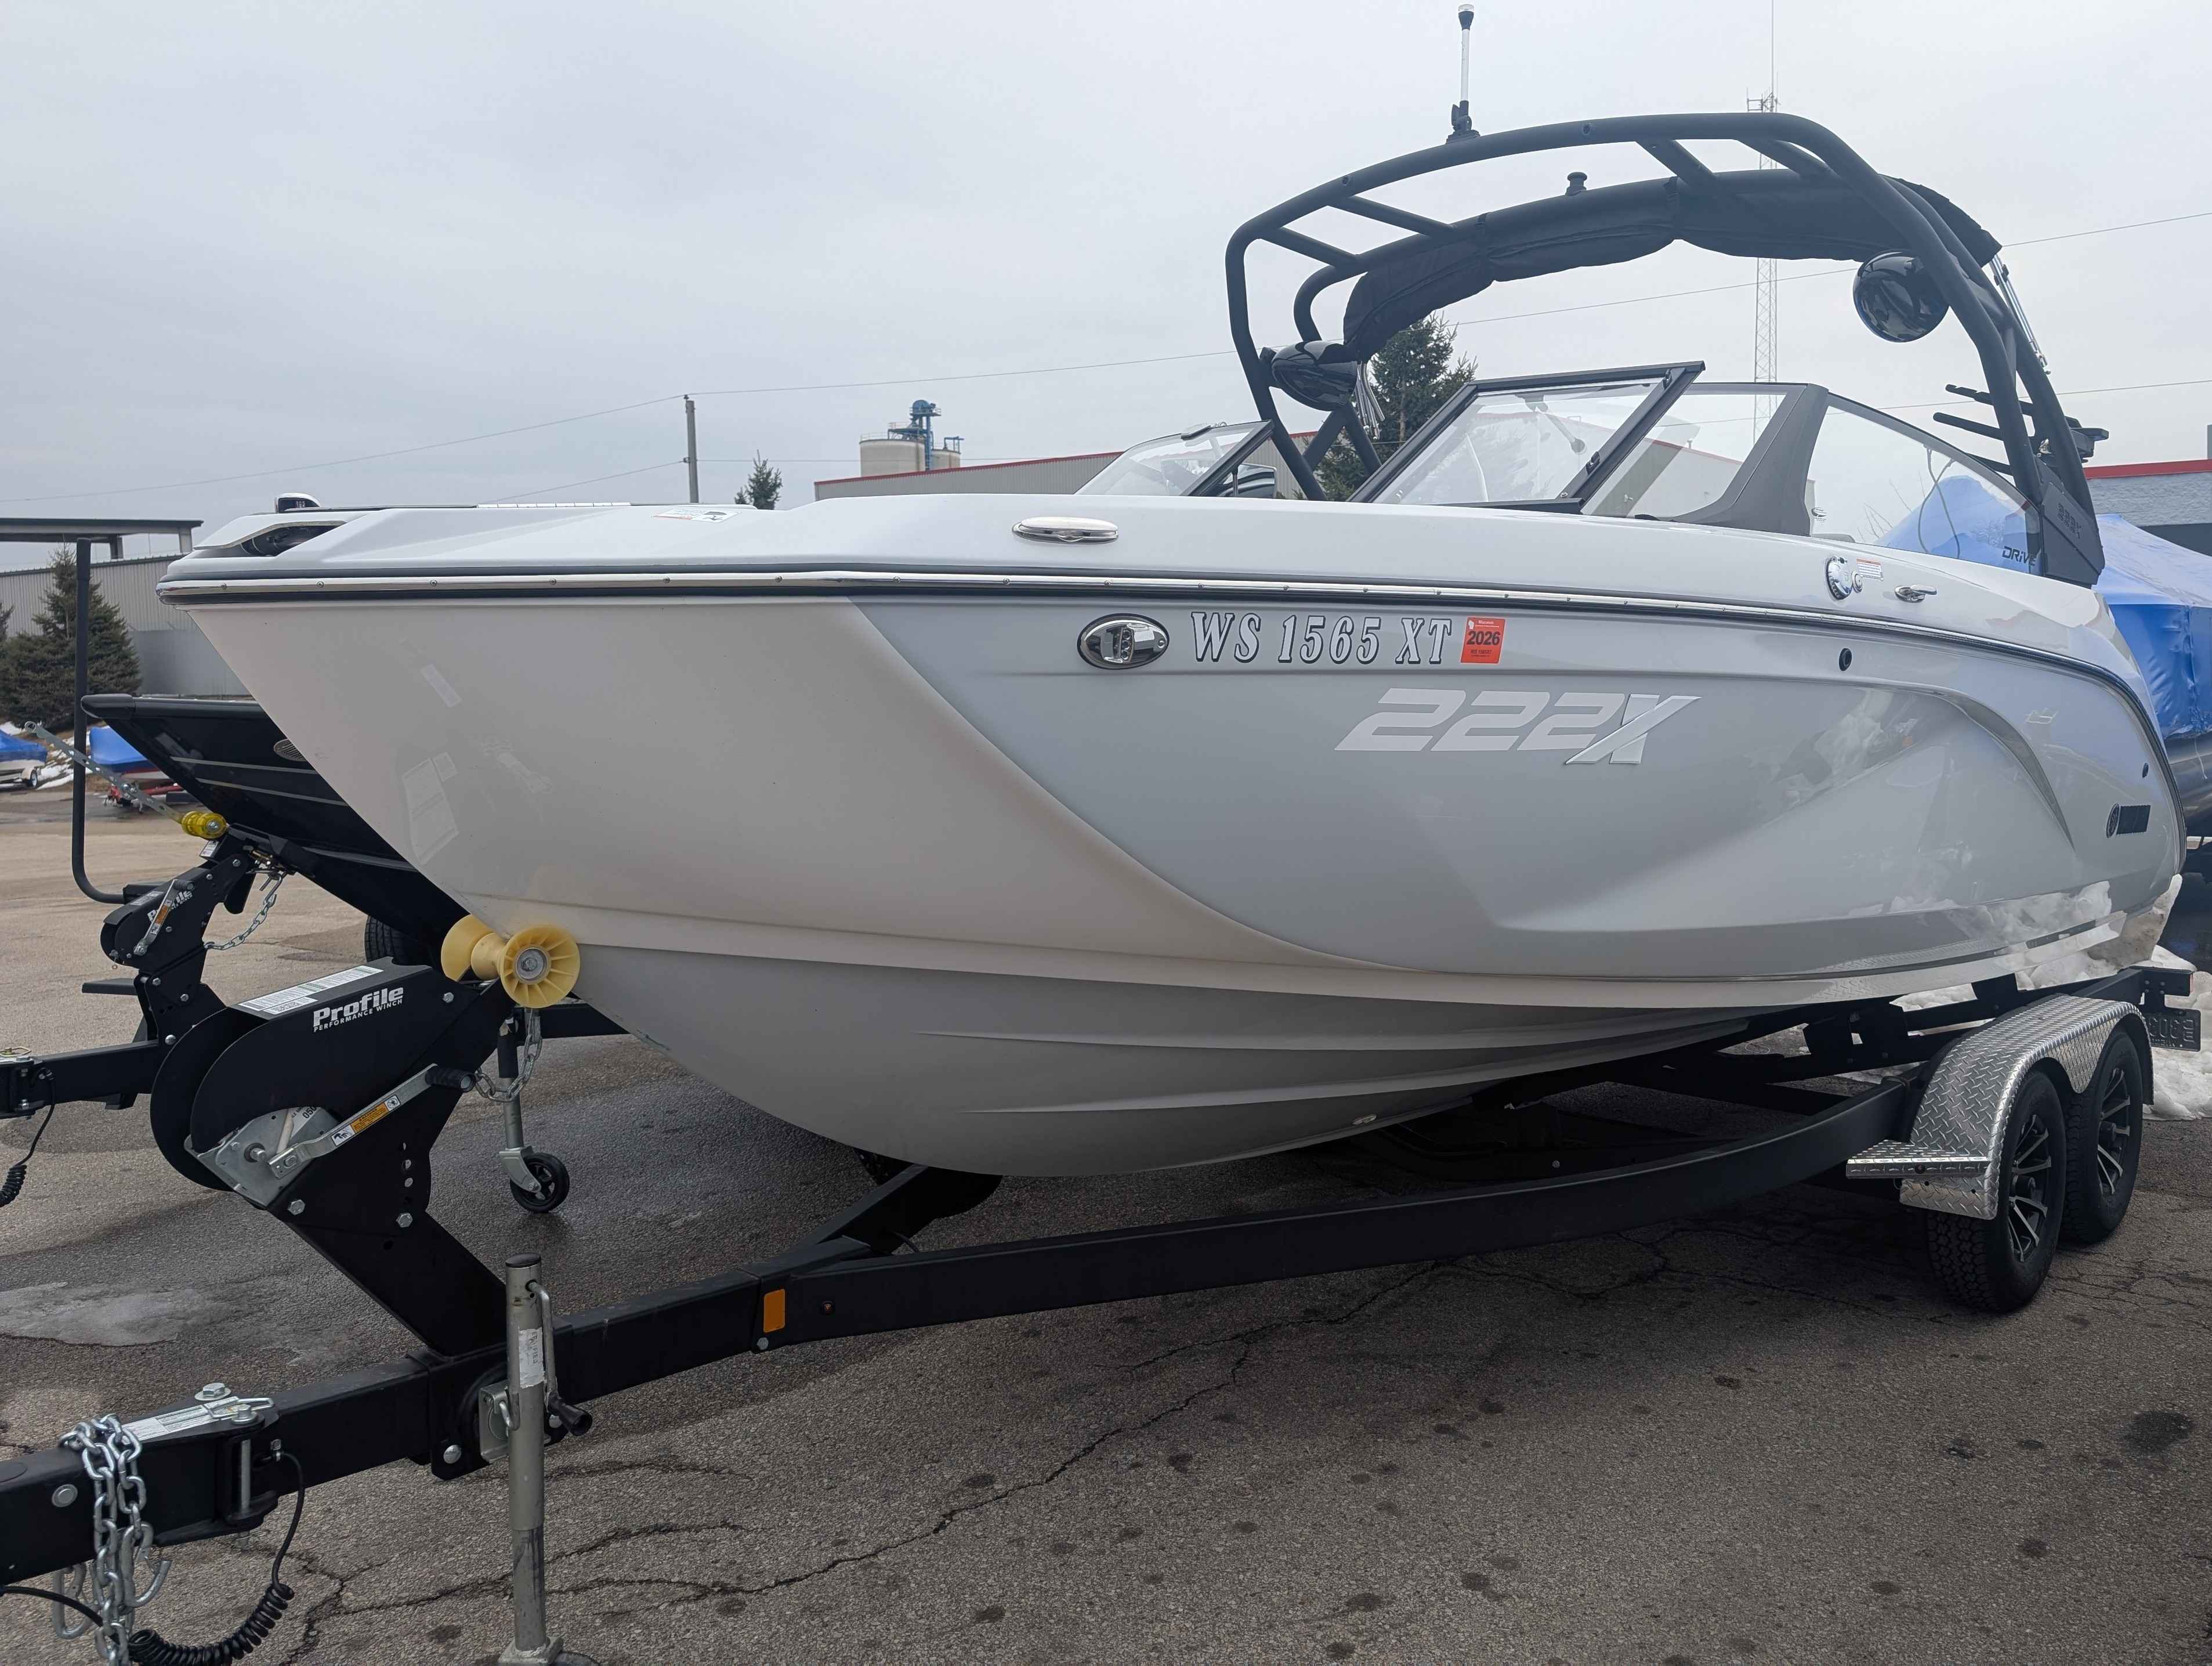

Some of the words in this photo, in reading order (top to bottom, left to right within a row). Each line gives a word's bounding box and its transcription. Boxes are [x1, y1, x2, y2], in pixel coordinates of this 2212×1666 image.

[1191, 612, 1262, 664] WS
[1278, 614, 1382, 664] 1565
[1395, 617, 1452, 664] XT
[1467, 630, 1501, 645] 2026
[1334, 688, 1702, 765] 222X
[313, 987, 404, 1027] Profile
[313, 1008, 373, 1033] PERFORMANCE
[376, 998, 403, 1012] WINCH
